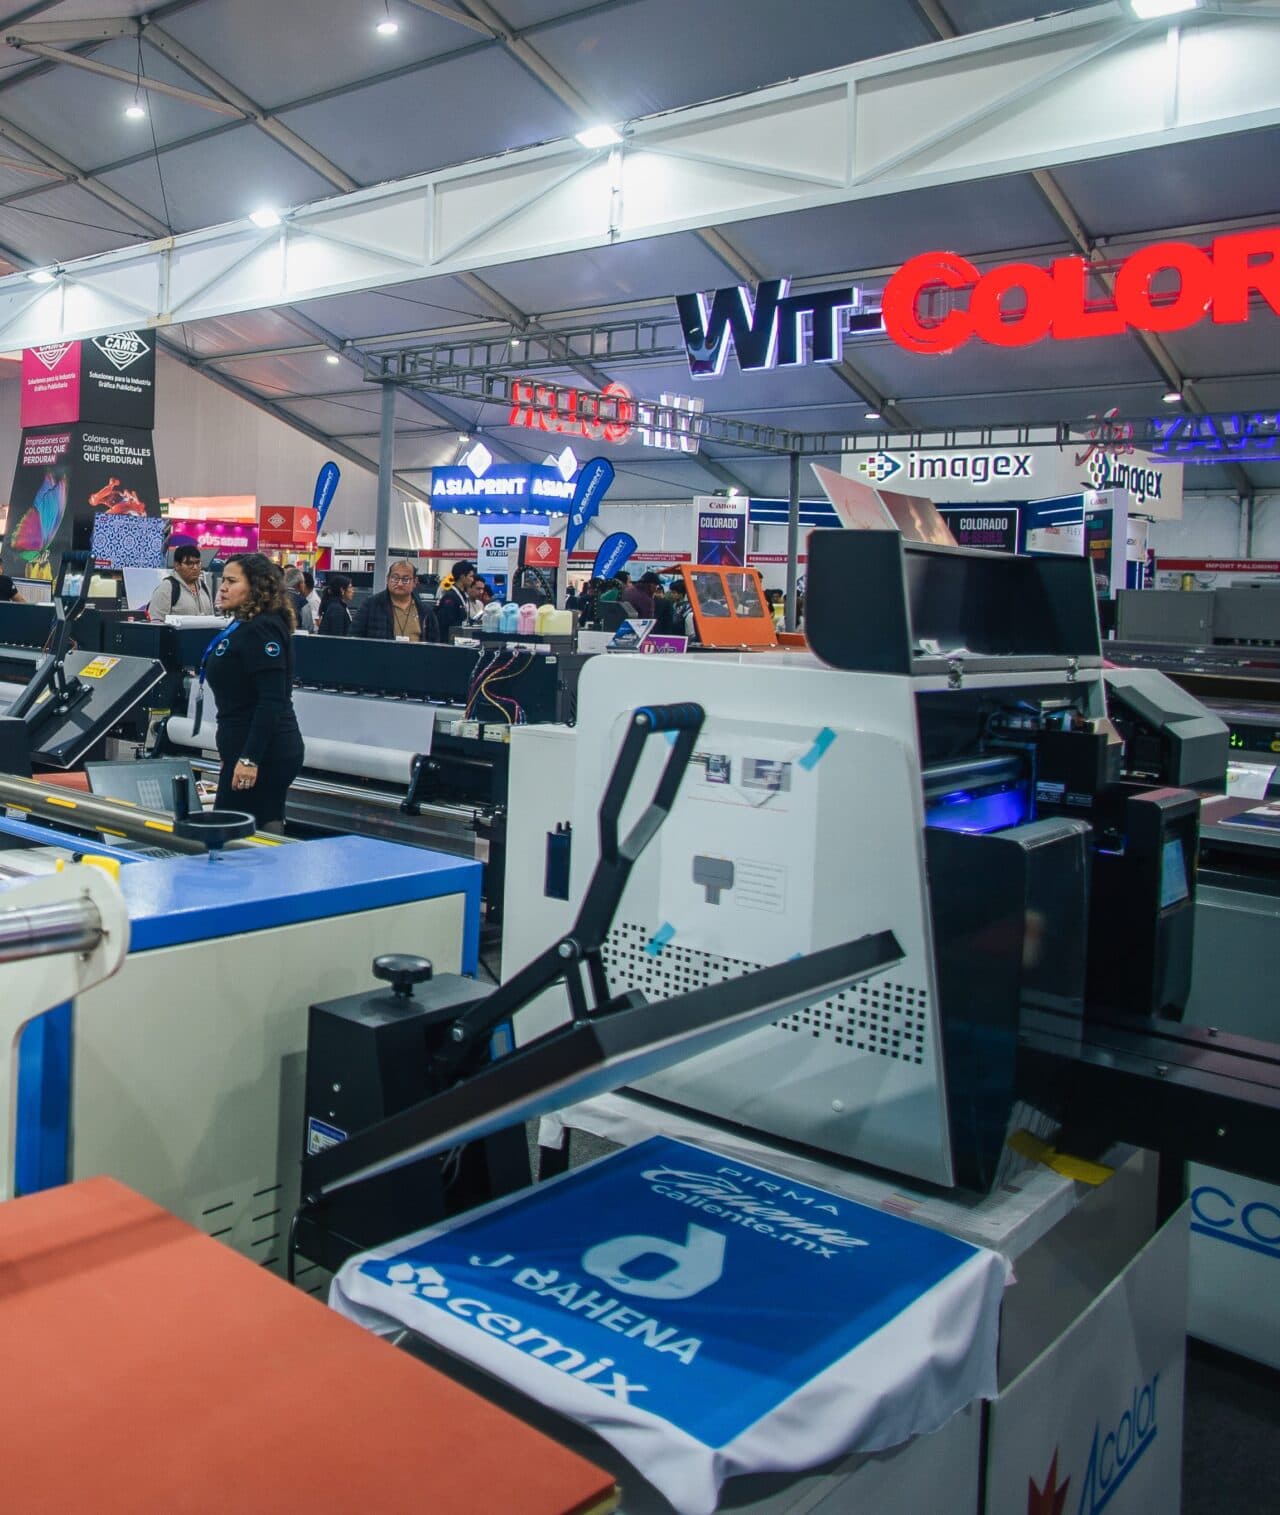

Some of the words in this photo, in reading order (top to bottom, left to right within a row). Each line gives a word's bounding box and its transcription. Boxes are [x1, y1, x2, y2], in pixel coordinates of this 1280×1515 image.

[104, 337, 138, 352] CAMS
[82, 433, 109, 444] Colores
[110, 437, 124, 446] que
[24, 446, 52, 455] COLORES
[53, 444, 65, 453] QUE
[83, 444, 112, 454] cautivan
[114, 446, 151, 457] DETALLES
[23, 454, 56, 464] PERDURAN
[83, 452, 100, 462] QUE
[101, 454, 143, 466] PERDURAN
[908, 452, 1032, 483] imagex
[1111, 454, 1163, 503] imagex
[433, 477, 527, 496] ASIAPRINT
[578, 466, 605, 514] ASIAPRINT
[709, 501, 737, 510] Canon
[700, 517, 739, 529] COLORADO
[959, 517, 1009, 531] COLORADO
[481, 536, 517, 548] AGP
[717, 1167, 840, 1217] PIRMA
[650, 1183, 839, 1260] caliente.mx
[514, 1267, 704, 1367] BAHENA
[445, 1296, 648, 1403] cemix
[1076, 1372, 1160, 1515] 4color
